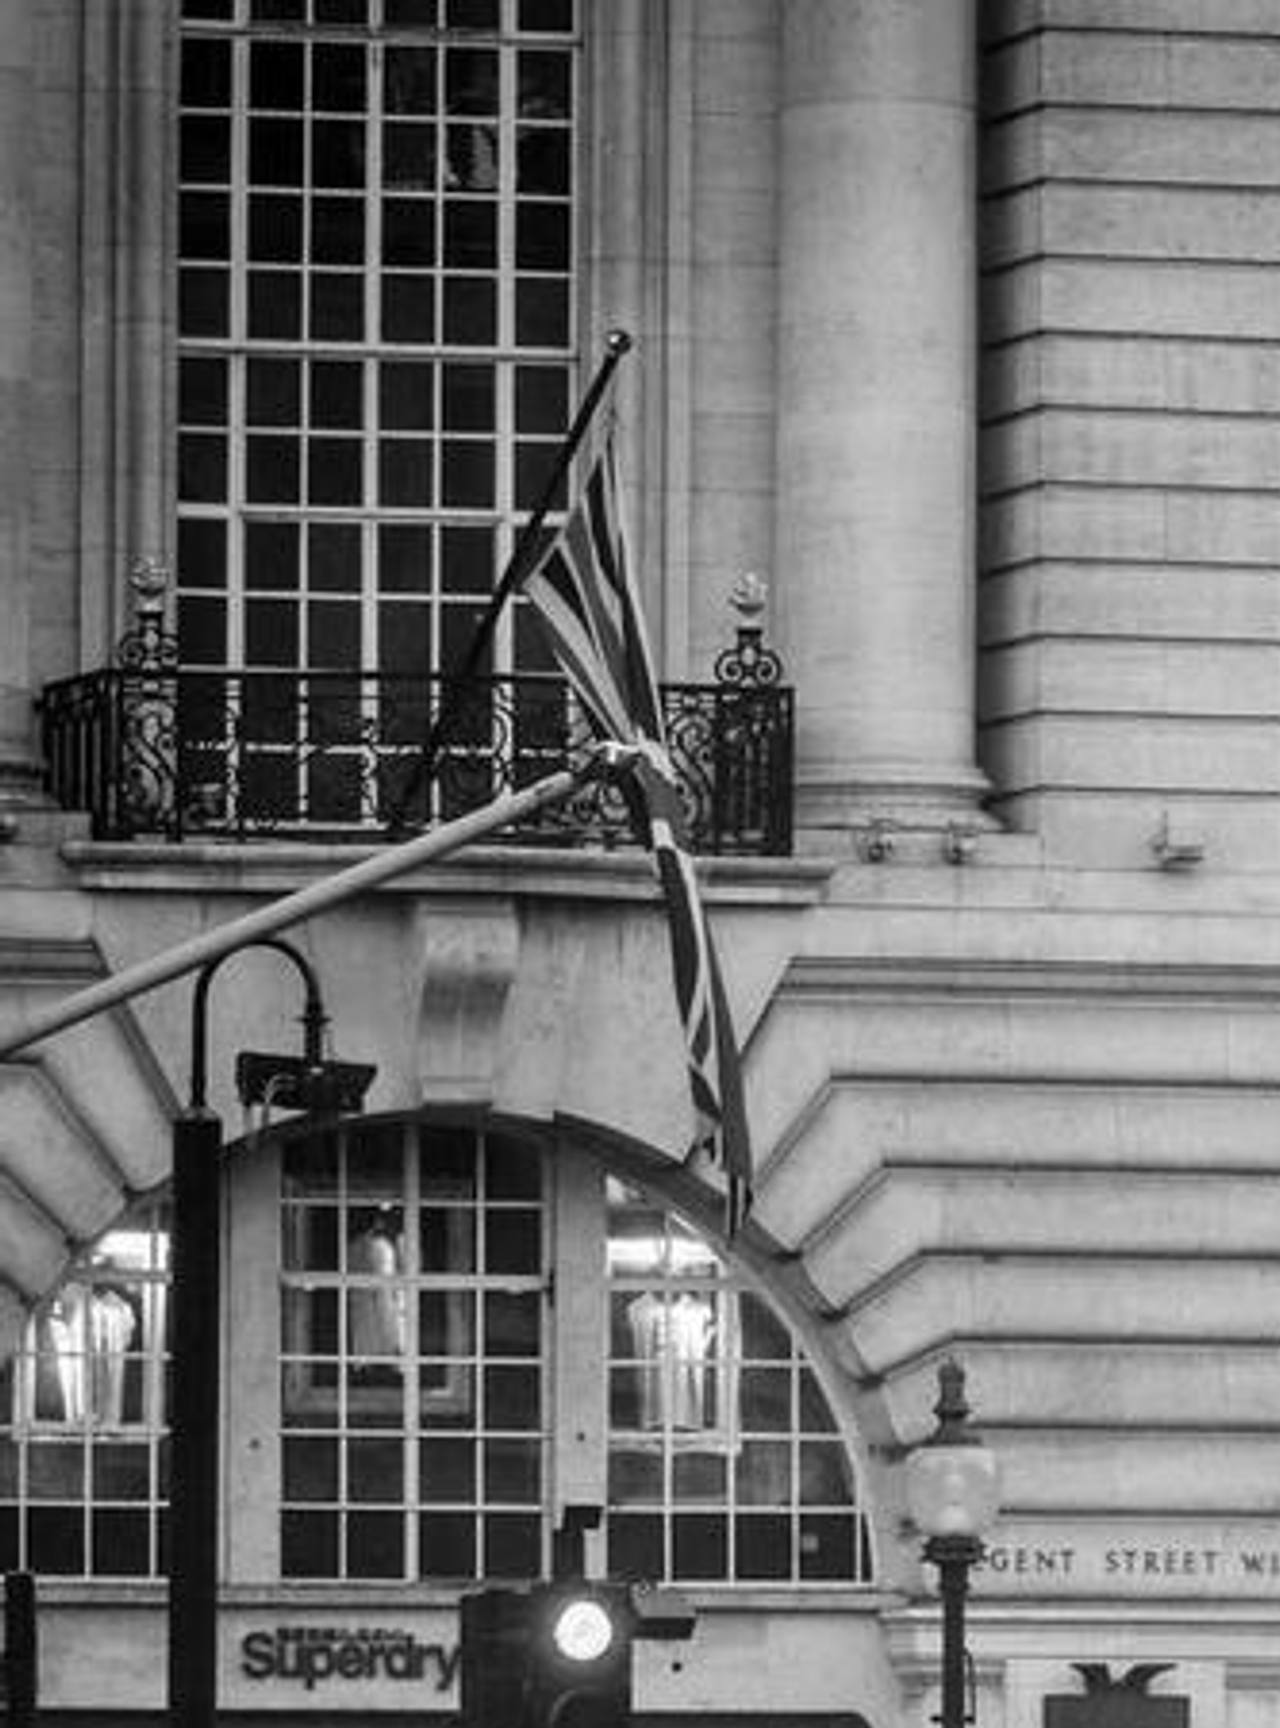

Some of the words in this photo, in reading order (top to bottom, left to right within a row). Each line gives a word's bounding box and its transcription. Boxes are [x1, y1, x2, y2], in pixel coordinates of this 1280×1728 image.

[972, 1548, 1075, 1573] GENT
[1105, 1549, 1222, 1573] STREET
[241, 1631, 460, 1691] Superdry
